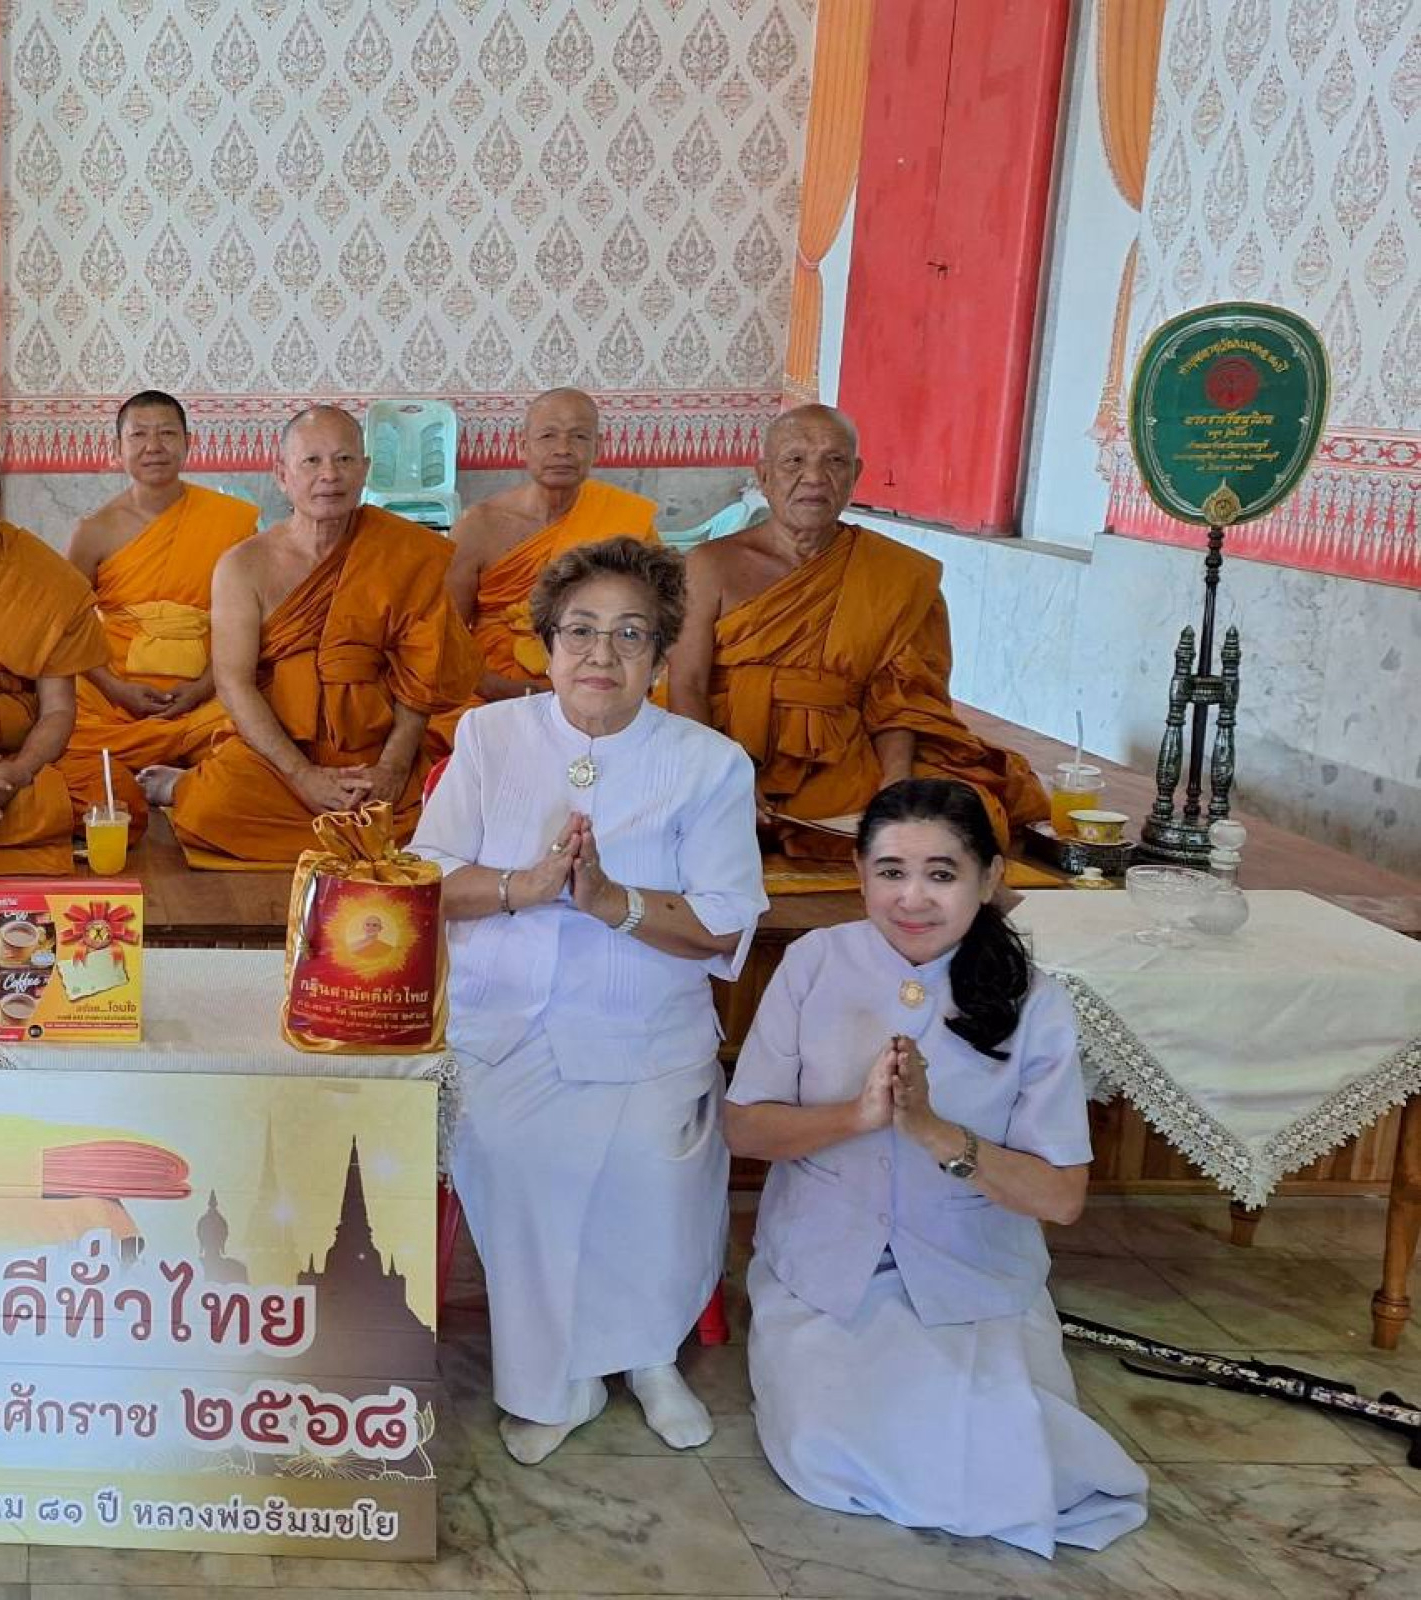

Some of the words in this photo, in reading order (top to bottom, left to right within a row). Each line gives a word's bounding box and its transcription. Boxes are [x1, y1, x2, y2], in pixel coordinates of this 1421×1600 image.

[3, 972, 40, 994] Coffee
[180, 1387, 408, 1449] ๒๕๖๘
[37, 1499, 83, 1522] ๘๑
[97, 1488, 119, 1524] ปี
[133, 1499, 396, 1537] หลวงพ่อธัมมชโย
